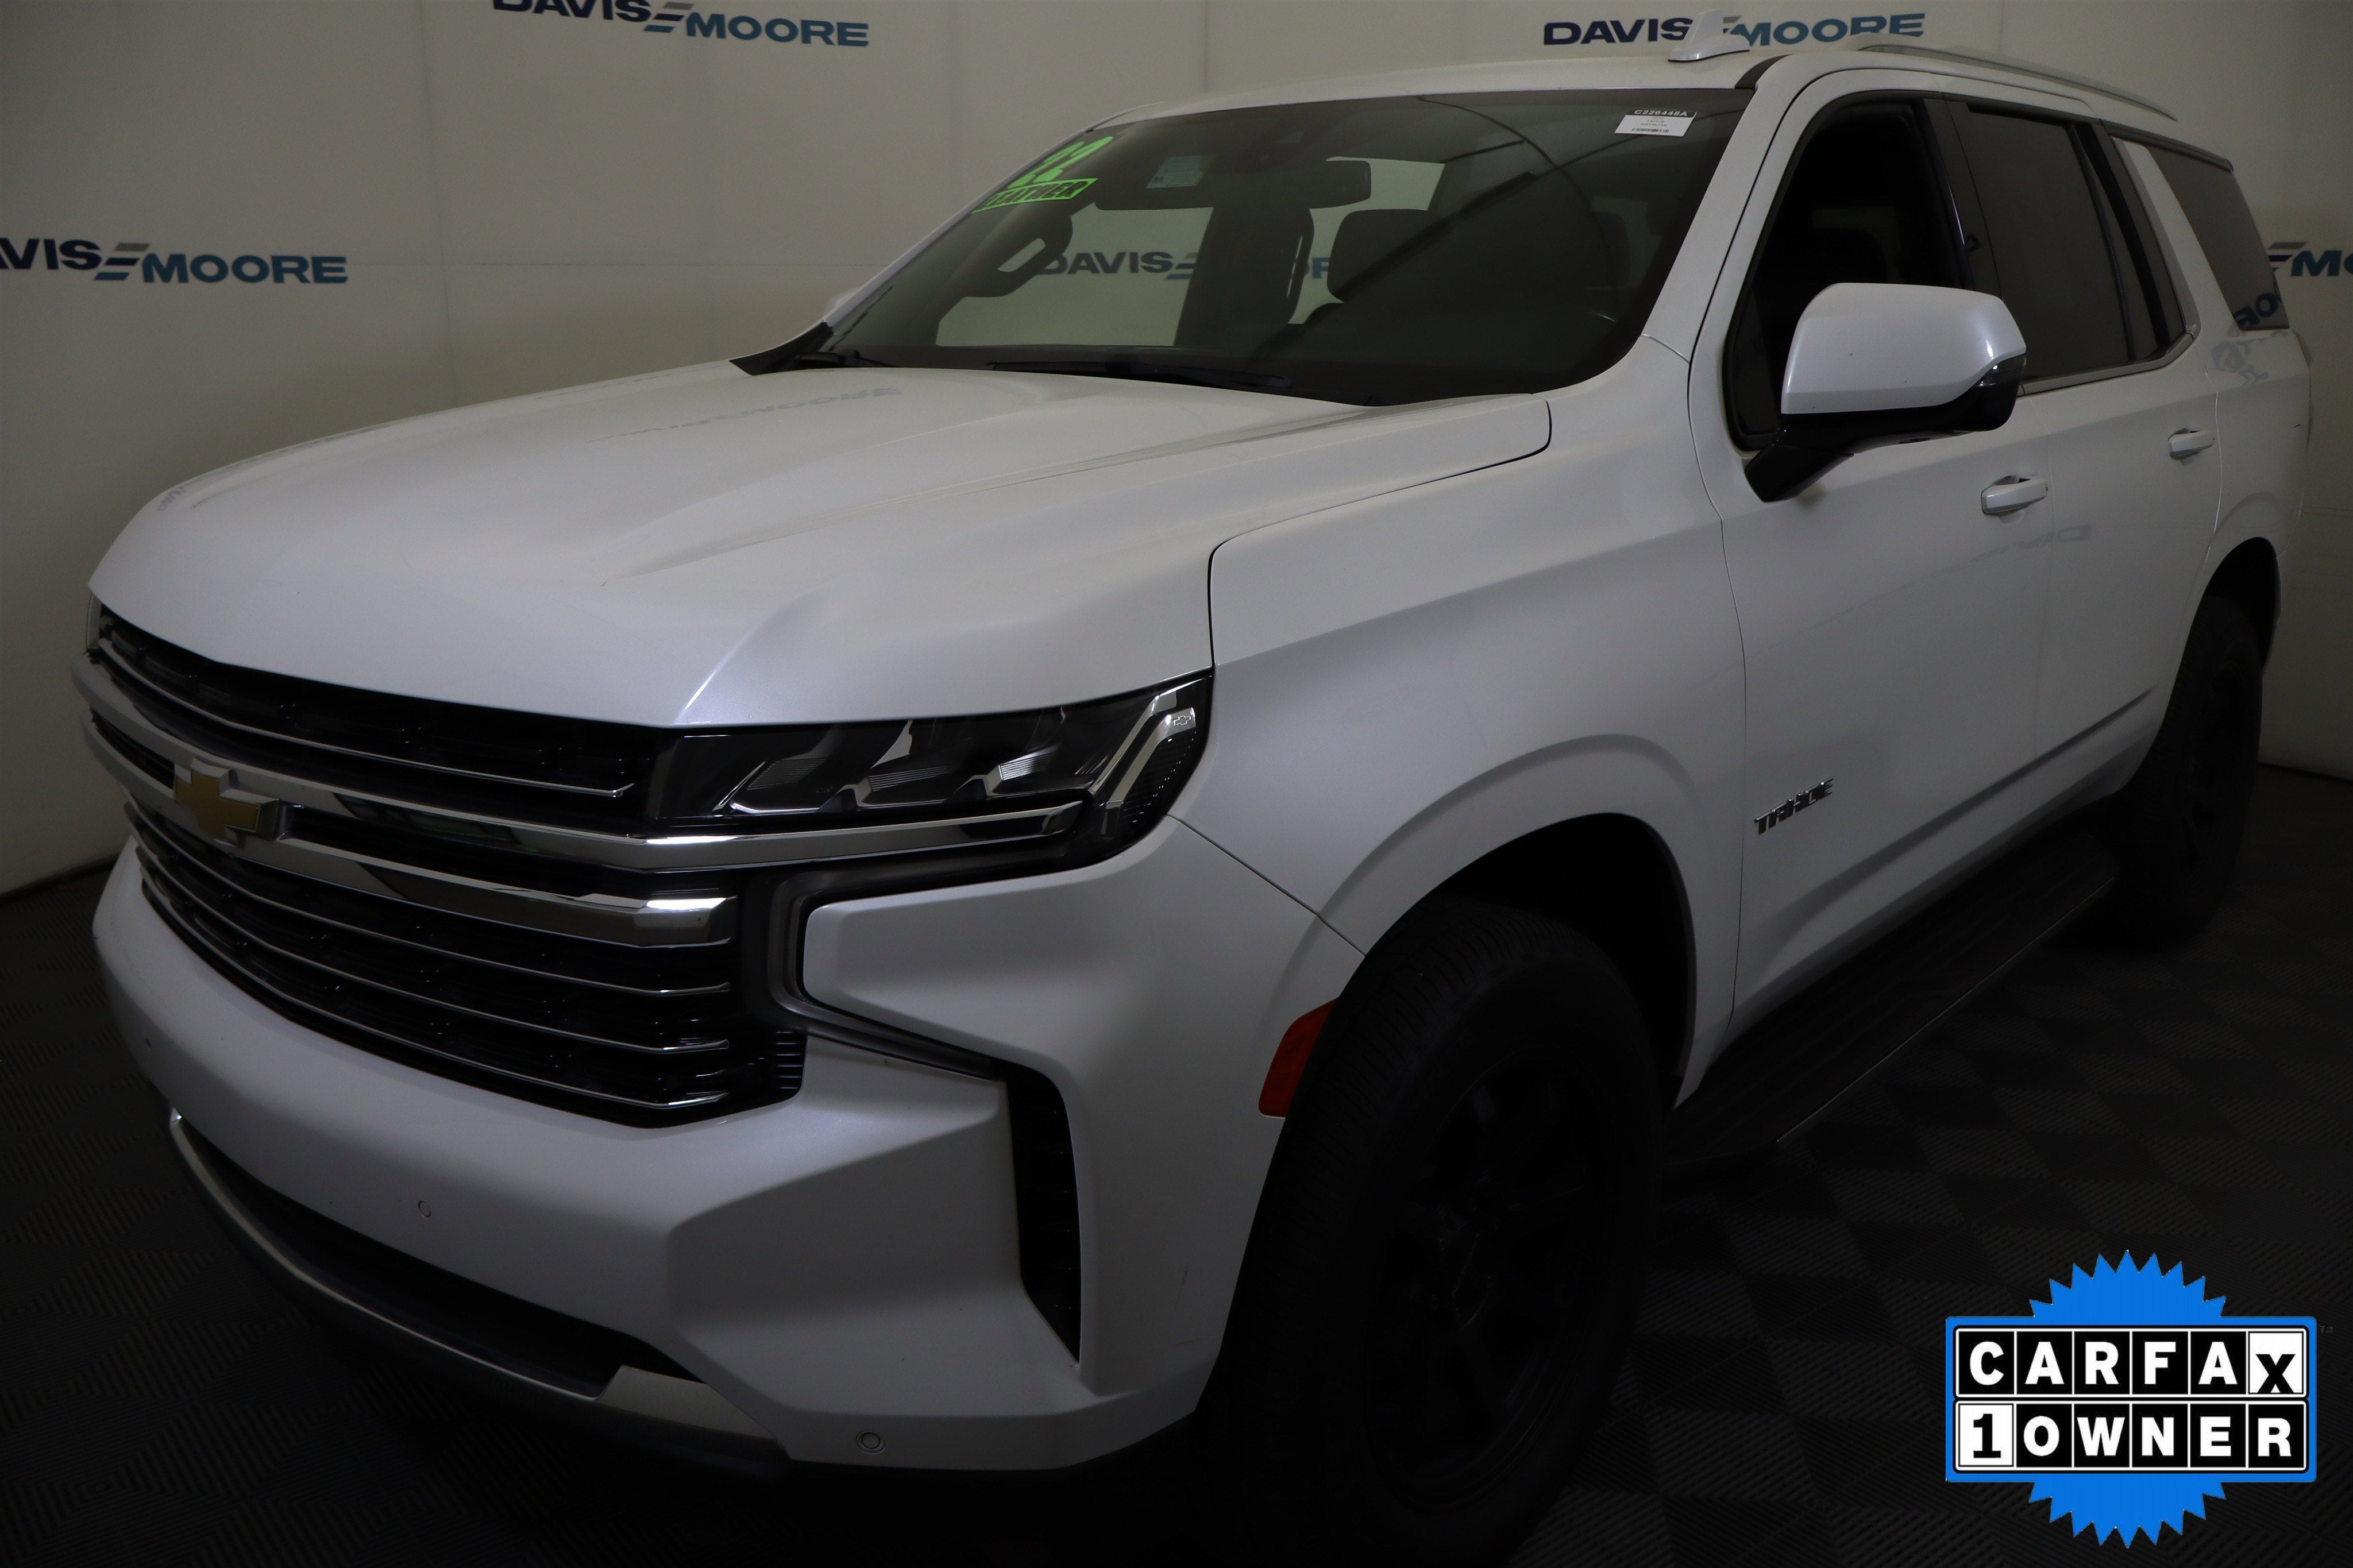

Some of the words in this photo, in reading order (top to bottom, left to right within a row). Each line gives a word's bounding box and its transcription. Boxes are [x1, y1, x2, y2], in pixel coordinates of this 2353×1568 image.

[686, 12, 869, 47] MOORE
[1544, 18, 1693, 45] DAVIS
[1730, 13, 1926, 47] MOORE
[0, 238, 102, 270] VIS
[141, 253, 348, 283] MOORE
[1754, 776, 1834, 835] TAHOE
